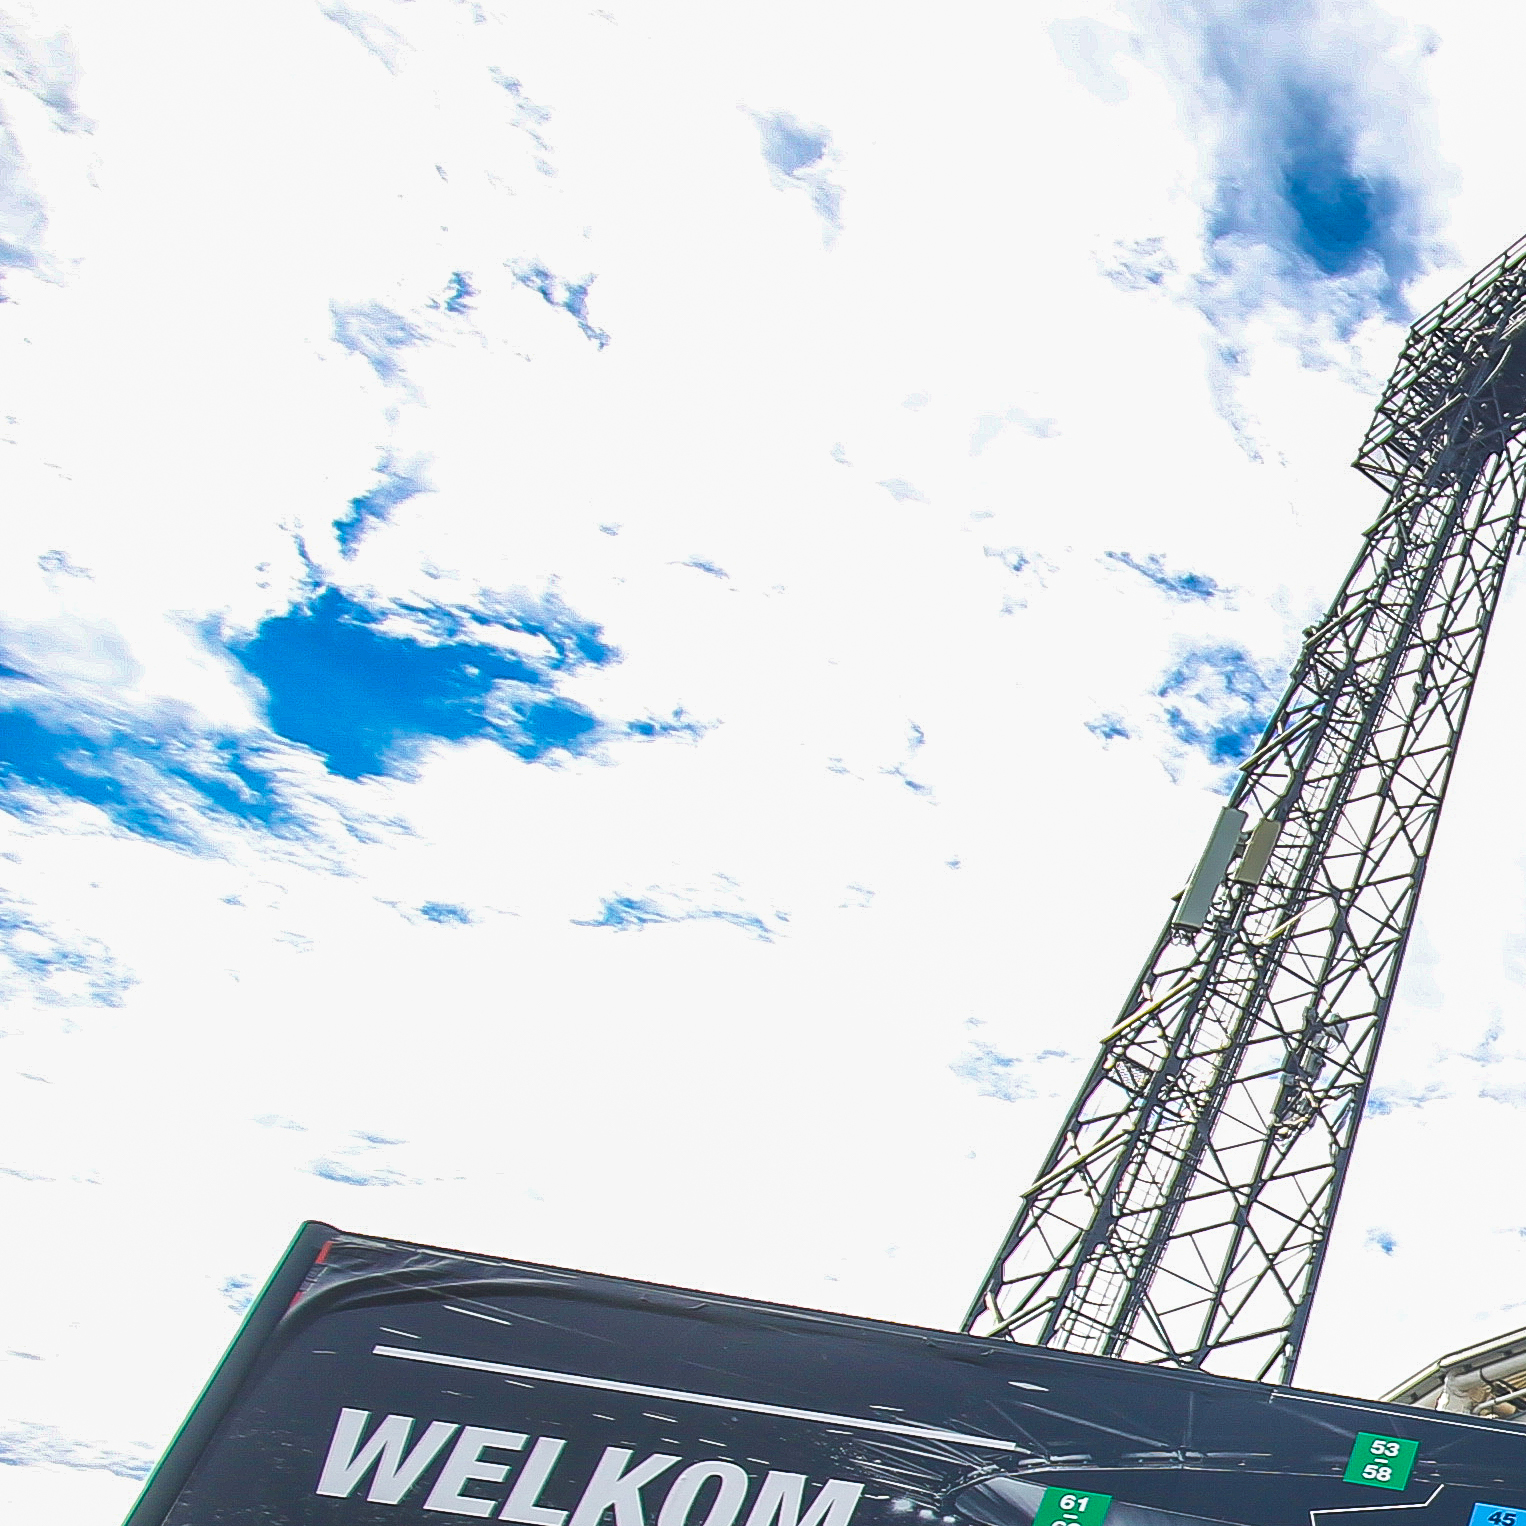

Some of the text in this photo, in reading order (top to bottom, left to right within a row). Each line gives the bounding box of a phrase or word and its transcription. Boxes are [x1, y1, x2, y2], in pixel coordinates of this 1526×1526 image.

[1370, 1439, 1399, 1457] 53
[1361, 1464, 1392, 1482] 58
[1059, 1494, 1089, 1512] 61
